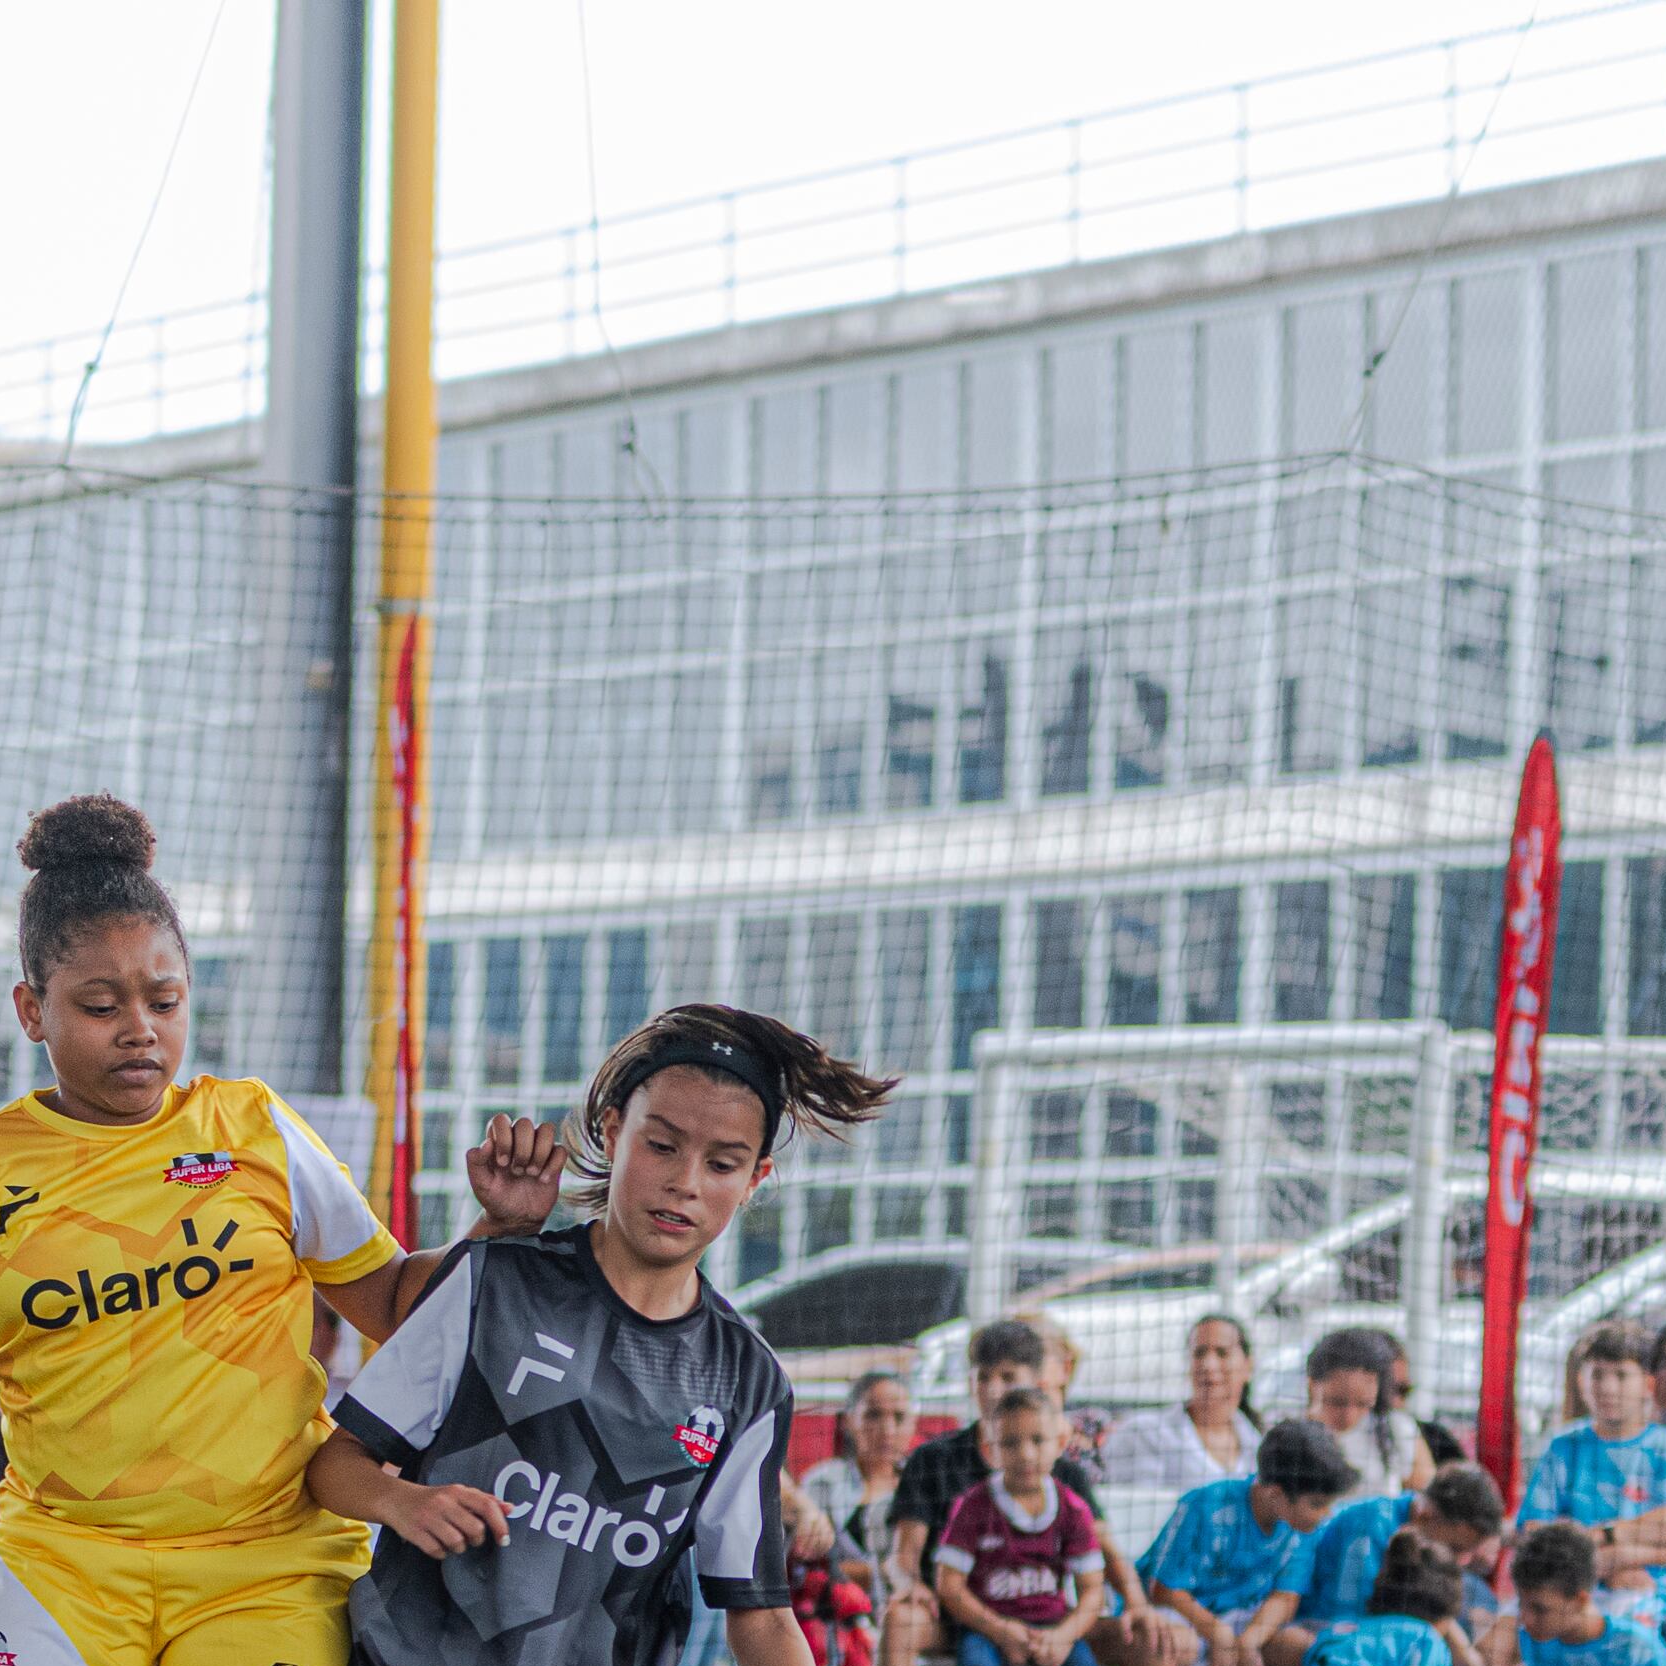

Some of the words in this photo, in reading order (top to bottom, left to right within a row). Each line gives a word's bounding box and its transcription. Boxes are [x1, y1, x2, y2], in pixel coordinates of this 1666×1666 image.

[170, 1165, 206, 1179] SUPER
[207, 1162, 233, 1173] LIGA
[191, 1175, 215, 1184] Claro
[174, 1173, 232, 1190] INTERNACIONAL
[21, 1255, 221, 1330] Claro
[679, 1429, 707, 1448] SUPE
[493, 1459, 661, 1568] Claro
